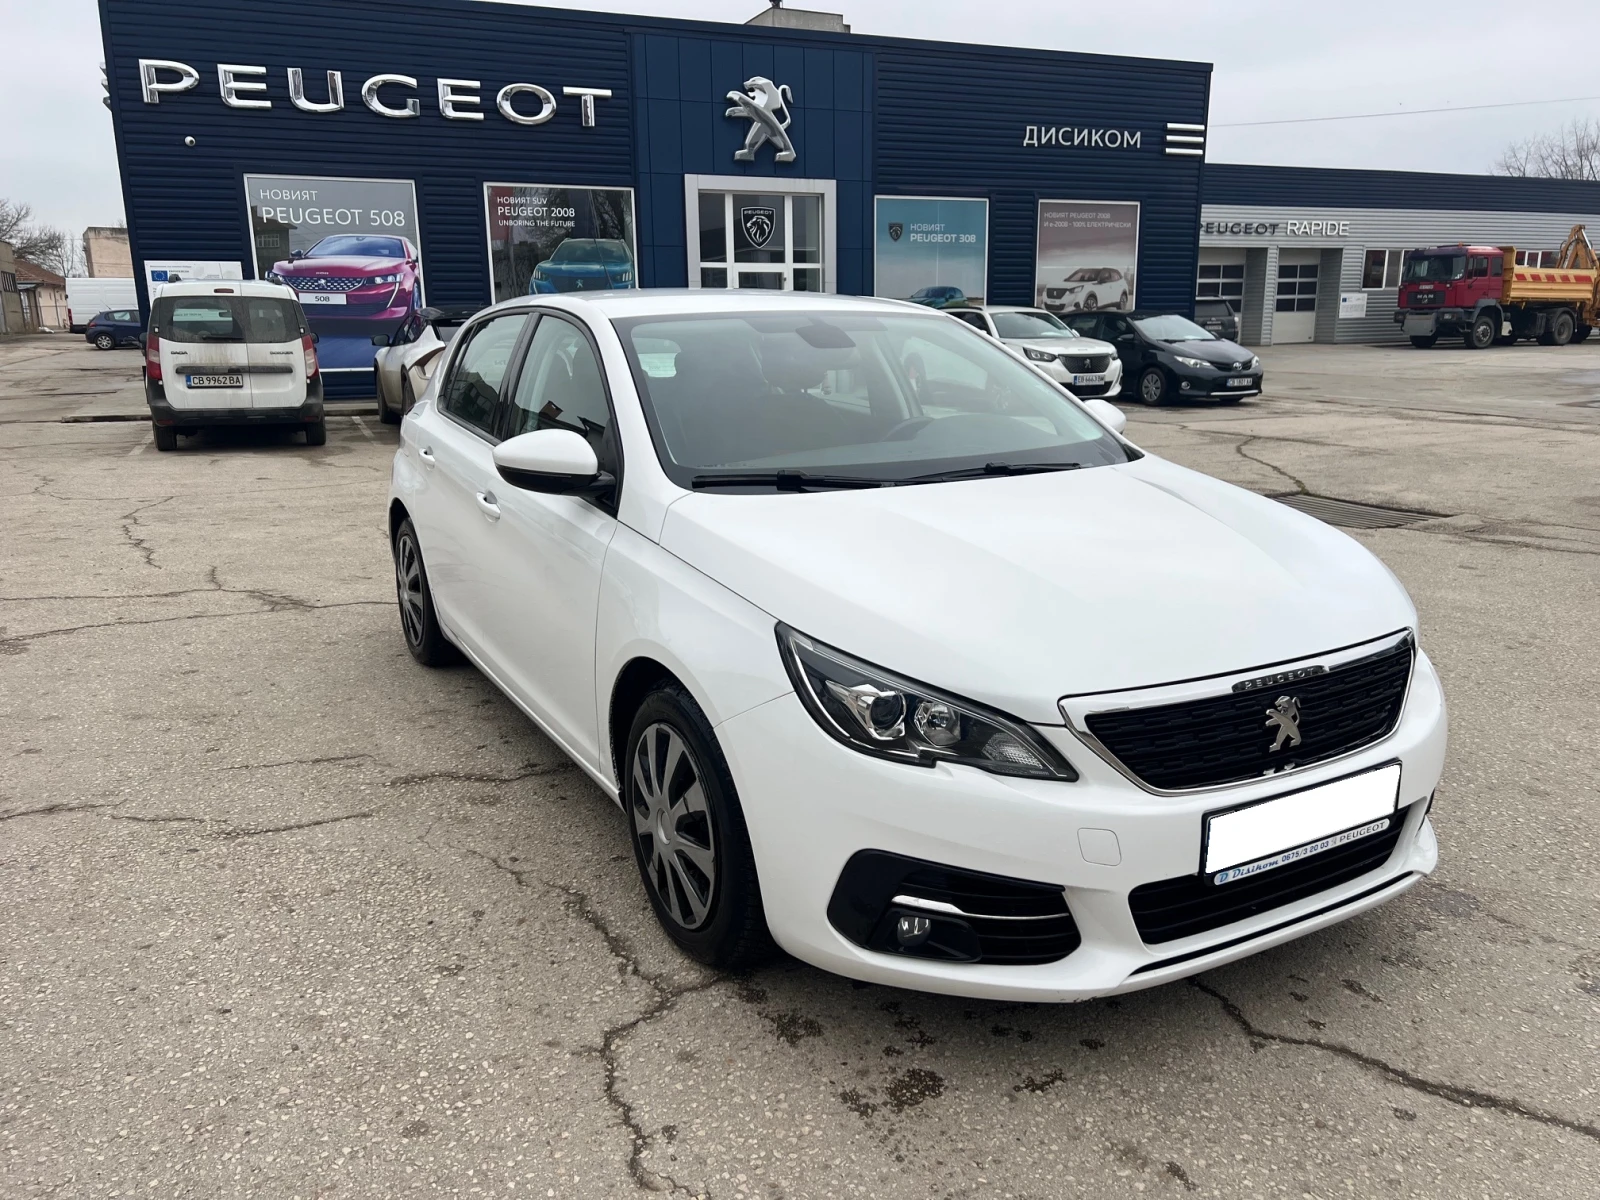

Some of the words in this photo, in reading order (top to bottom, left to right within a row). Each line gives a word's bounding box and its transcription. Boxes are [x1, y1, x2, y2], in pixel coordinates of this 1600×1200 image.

[138, 58, 612, 127] PEUGEOT
[1023, 125, 1142, 149] ДИСИКОМ
[260, 189, 318, 201] НОВИЯТ
[497, 196, 530, 205] НОВИЯТ
[262, 207, 363, 226] PEUGEOT
[370, 210, 405, 227] 508
[497, 206, 548, 217] PEUGEOT
[551, 207, 575, 218] 2008
[498, 219, 535, 227] UNBORING
[551, 220, 576, 228] FUTURE
[910, 223, 946, 232] НОВИЯТ
[1287, 220, 1351, 236] RAPIDE
[910, 233, 957, 243] PEUGEOT
[959, 234, 977, 243] 308
[192, 376, 205, 385] CB
[205, 376, 227, 385] 9962
[229, 376, 241, 385] BA
[1245, 667, 1314, 690] PEUGEOT
[1309, 844, 1319, 853] 20
[1320, 840, 1330, 849] 03
[1339, 821, 1386, 842] PEUGEOT
